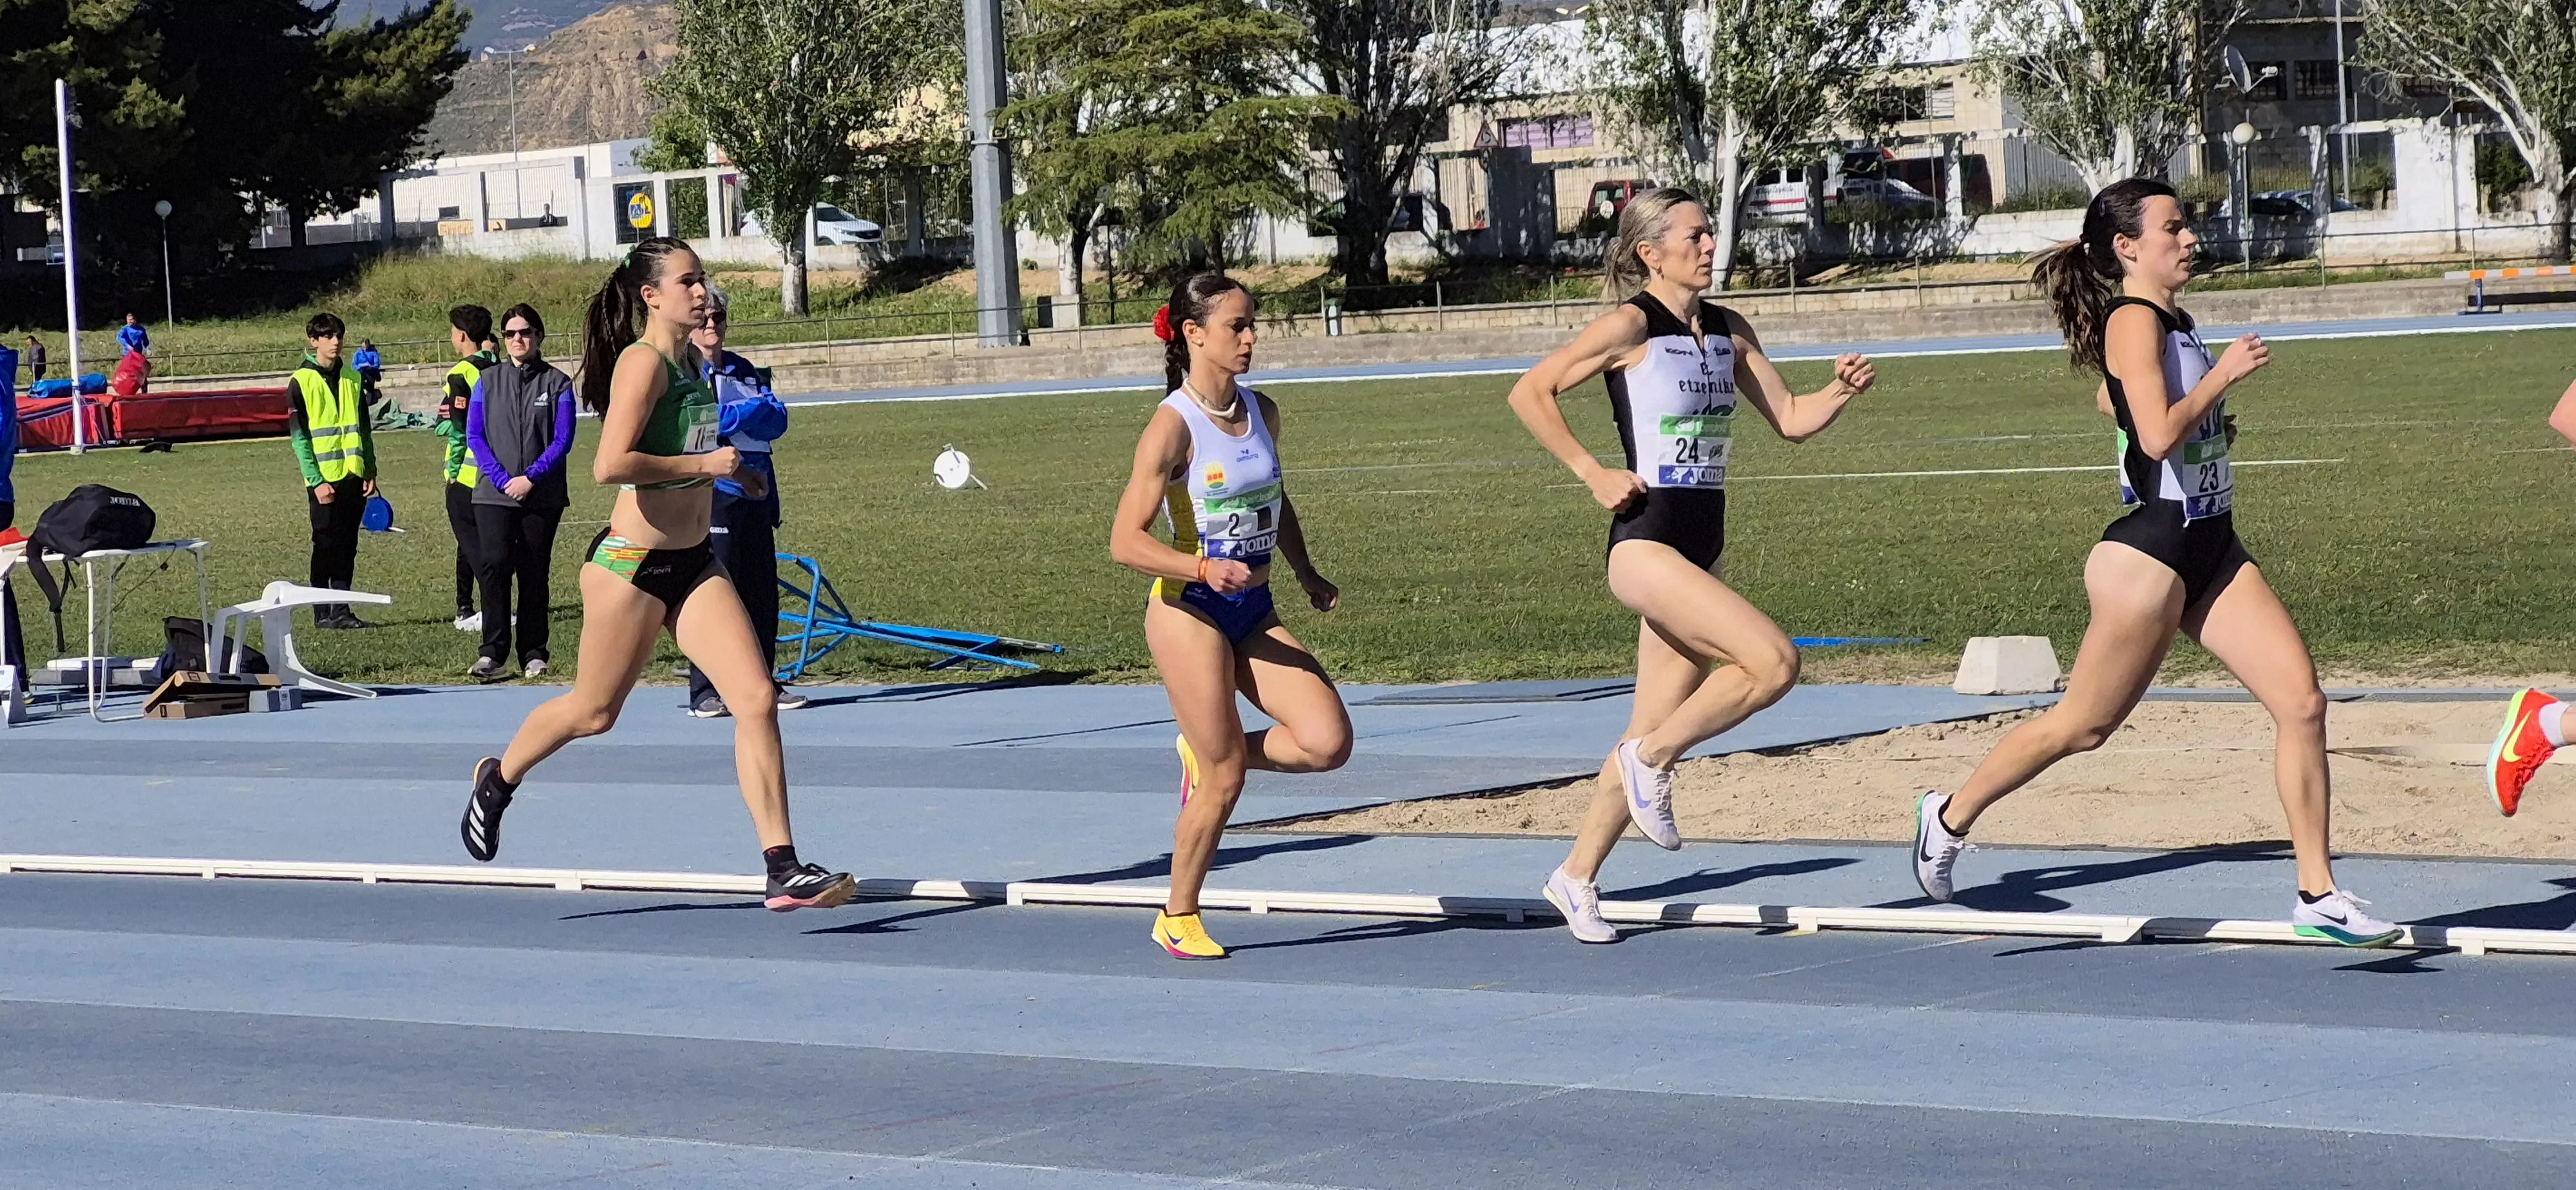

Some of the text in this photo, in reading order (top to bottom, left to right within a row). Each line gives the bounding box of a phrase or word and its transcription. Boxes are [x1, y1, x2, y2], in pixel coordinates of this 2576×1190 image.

[1676, 437, 1699, 464] 24
[1689, 467, 1723, 484] Joma
[2199, 461, 2219, 493] 23
[1228, 513, 1240, 537] 2
[1236, 532, 1276, 556] Joma
